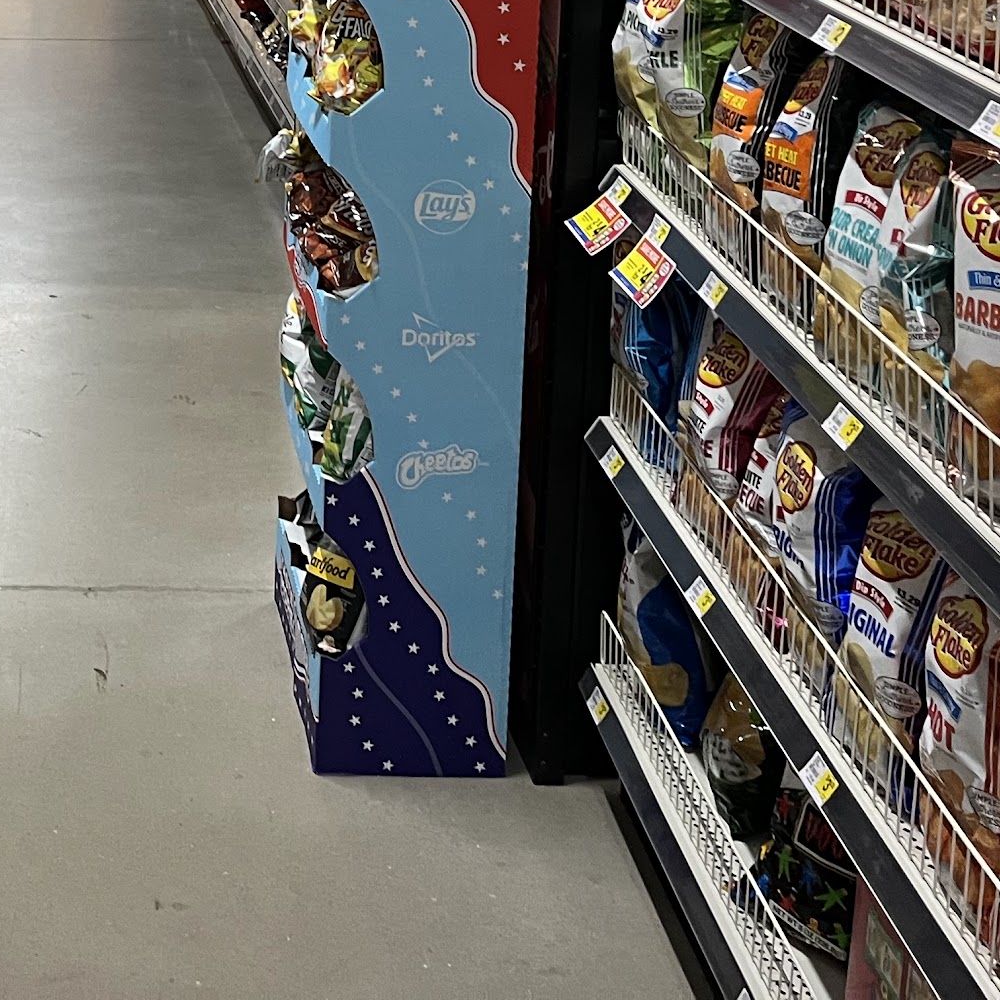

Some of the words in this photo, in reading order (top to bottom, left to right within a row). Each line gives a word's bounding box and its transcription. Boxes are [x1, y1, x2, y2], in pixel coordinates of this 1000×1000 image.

[778, 144, 799, 165] HEAT
[836, 233, 875, 270] ONION
[851, 218, 879, 247] CREA
[975, 271, 992, 286] Thin
[955, 292, 1000, 332] BARB
[401, 327, 477, 349] Doritos
[398, 445, 477, 489] Cheetos
[850, 602, 896, 659] IGINAL
[935, 626, 971, 669] Flake
[928, 700, 956, 753] HOT
